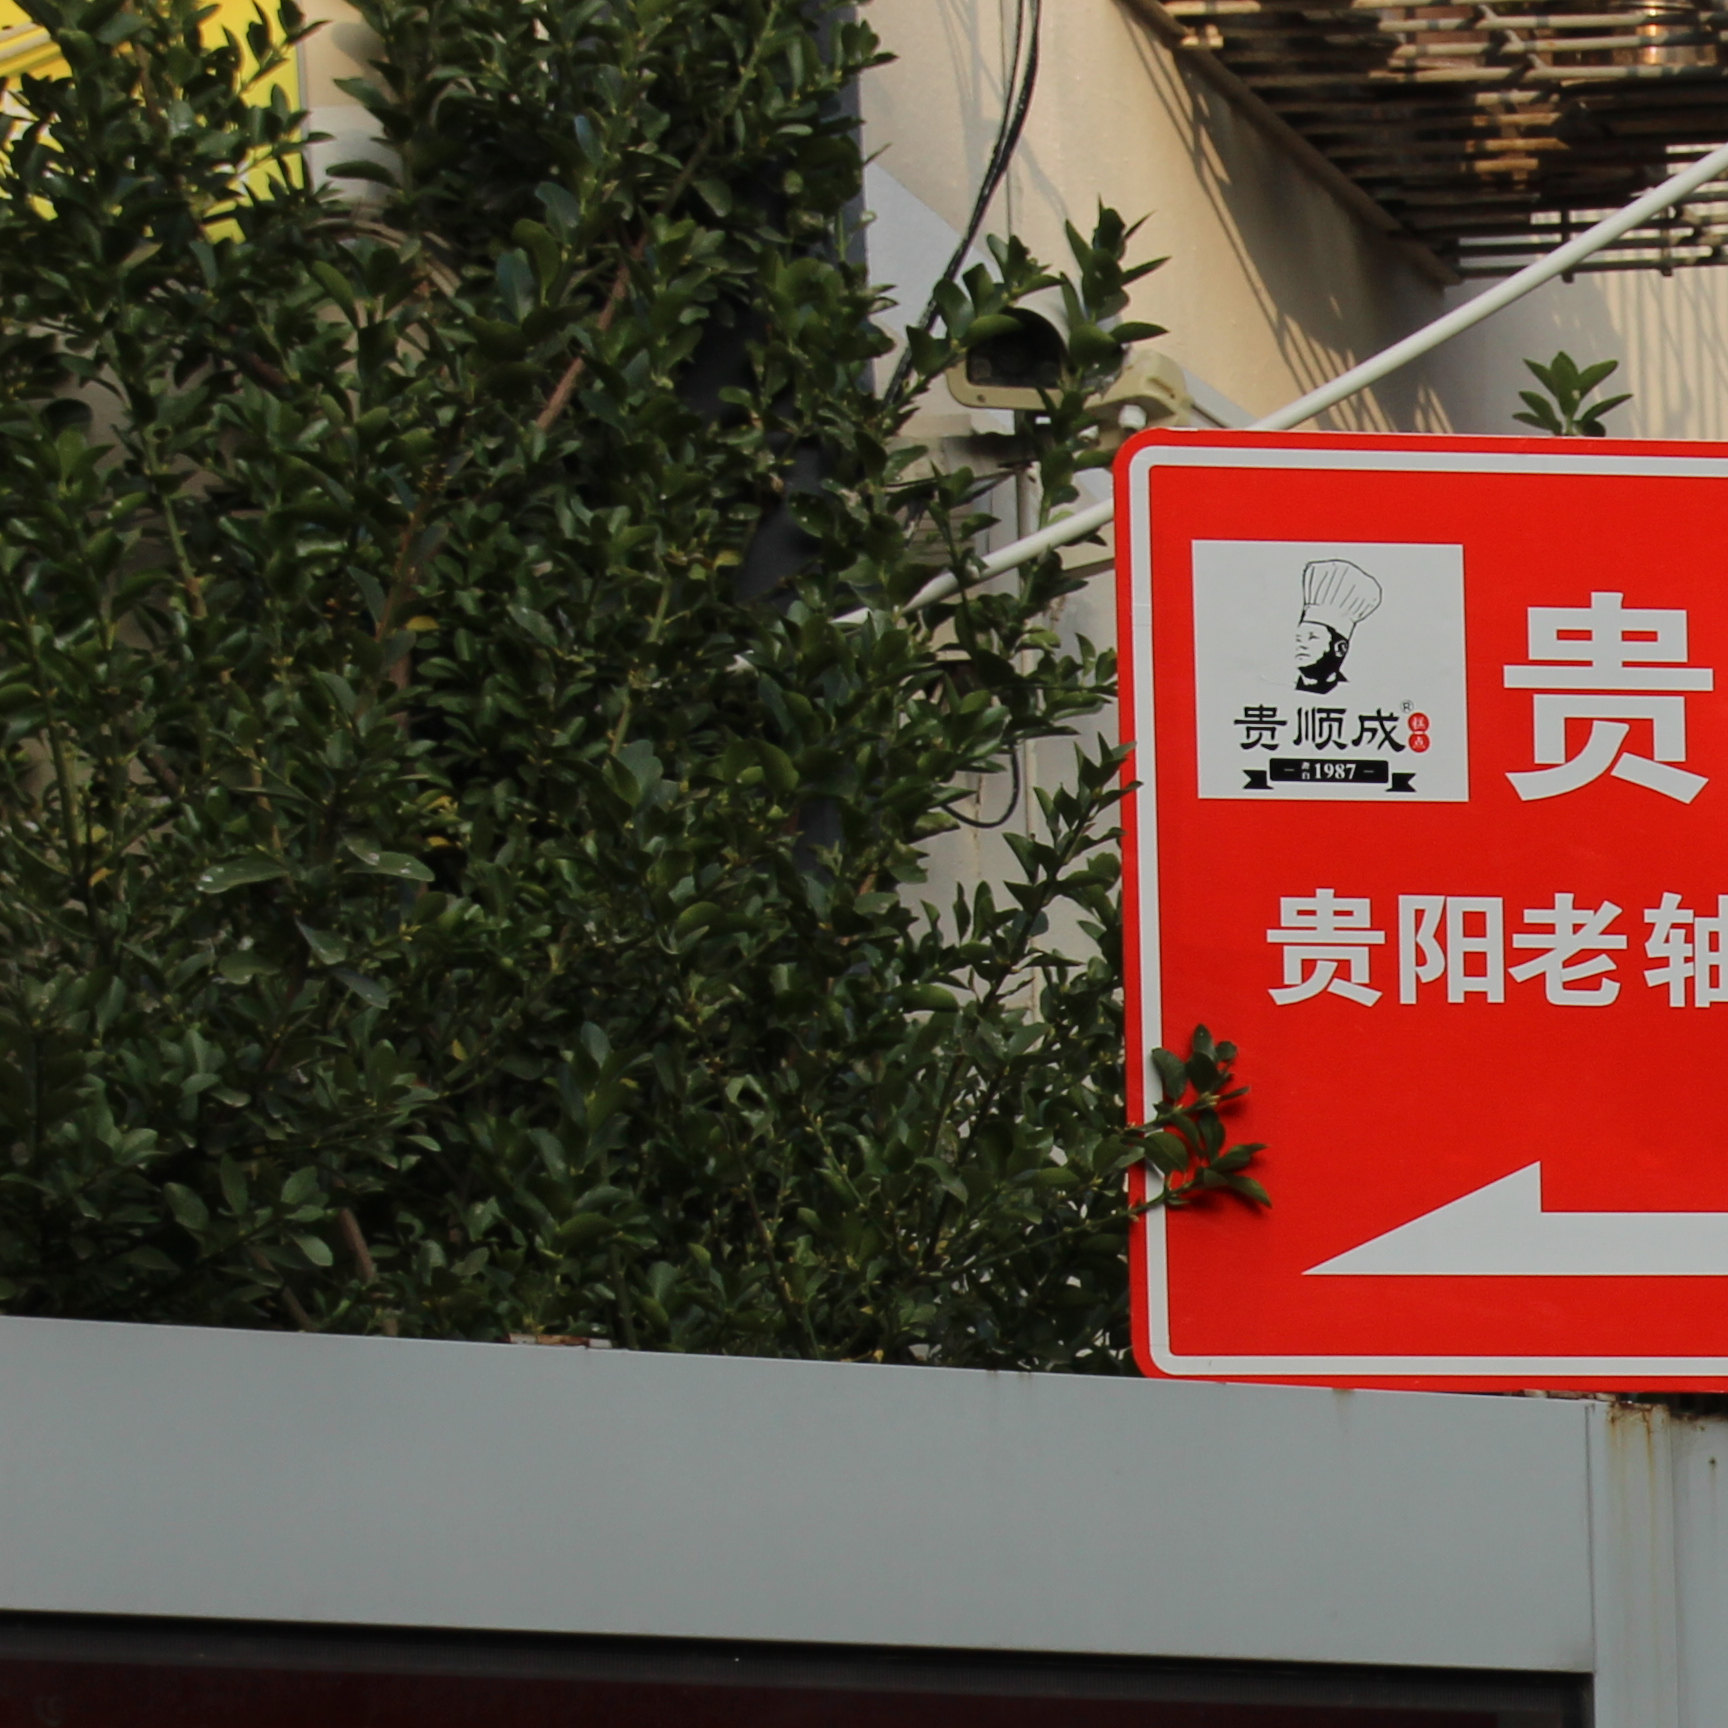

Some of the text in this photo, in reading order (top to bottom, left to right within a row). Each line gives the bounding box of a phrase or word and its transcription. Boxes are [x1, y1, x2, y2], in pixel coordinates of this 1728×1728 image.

[1233, 704, 1407, 753] 贵顺成
[1314, 762, 1357, 780] 1987
